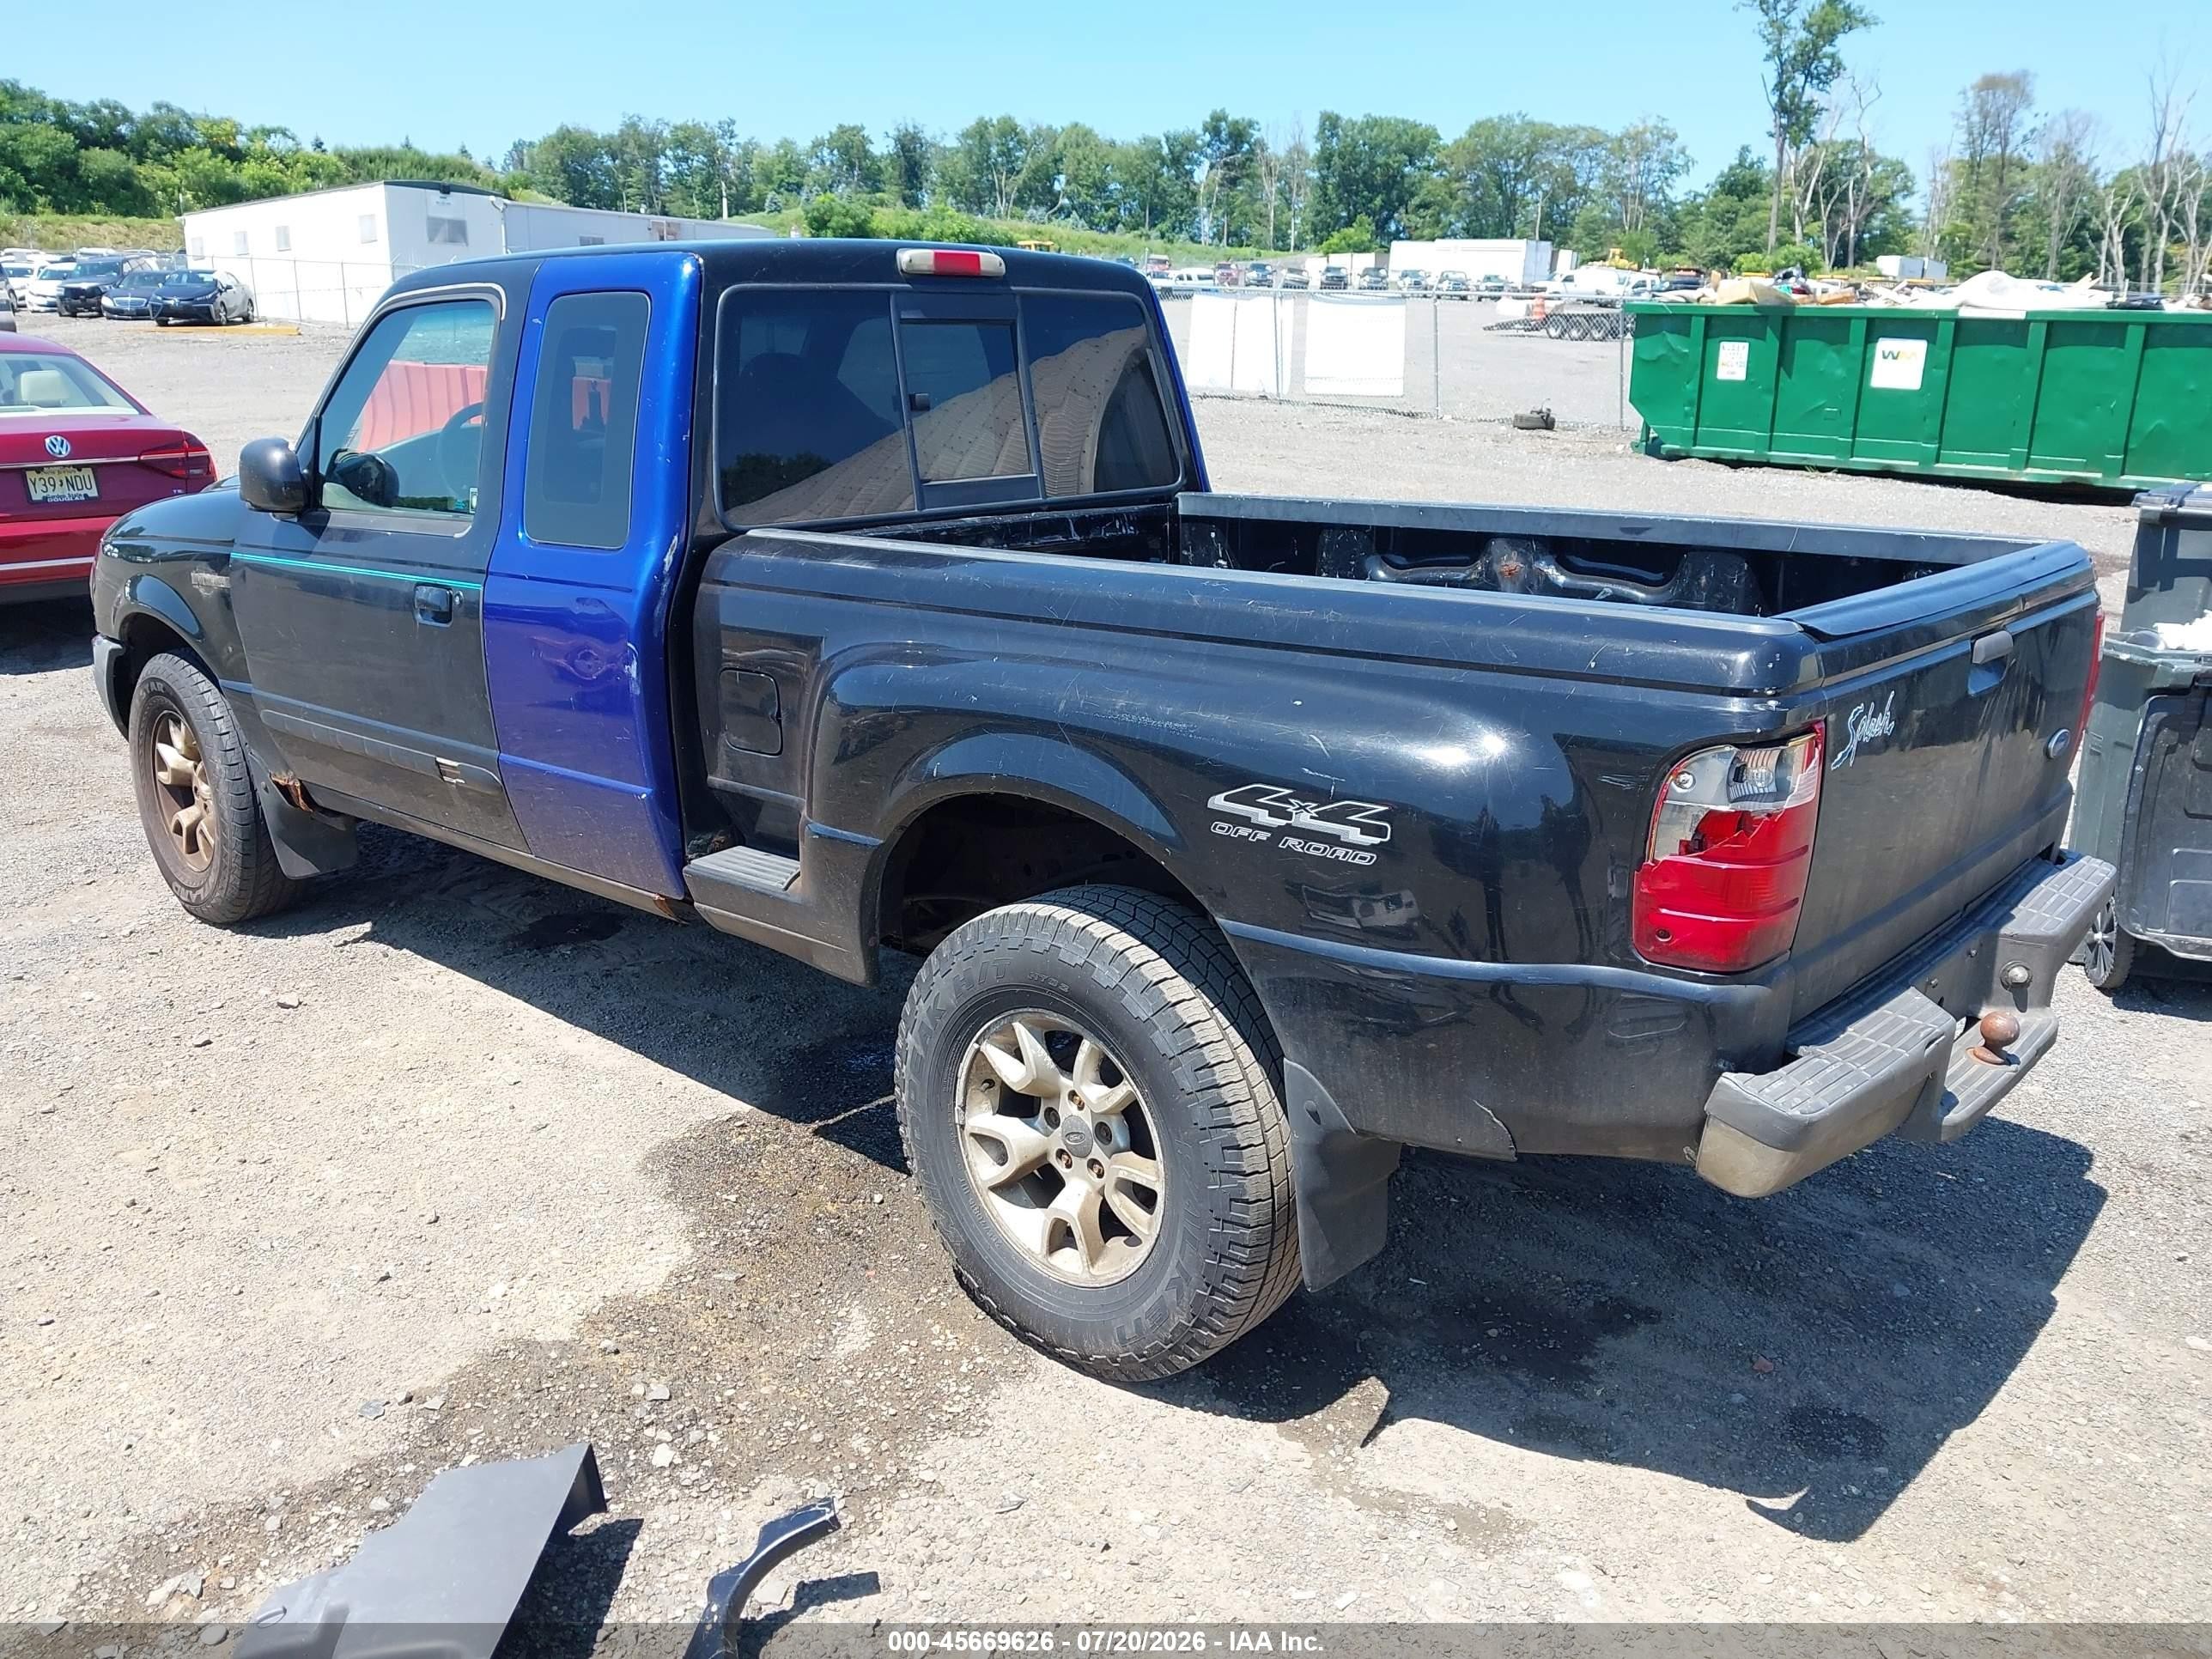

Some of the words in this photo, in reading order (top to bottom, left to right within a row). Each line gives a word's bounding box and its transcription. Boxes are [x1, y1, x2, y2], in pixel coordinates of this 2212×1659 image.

[1831, 690, 1895, 770] Splash
[1210, 821, 1272, 842] OFF
[1278, 836, 1377, 866] ROAD
